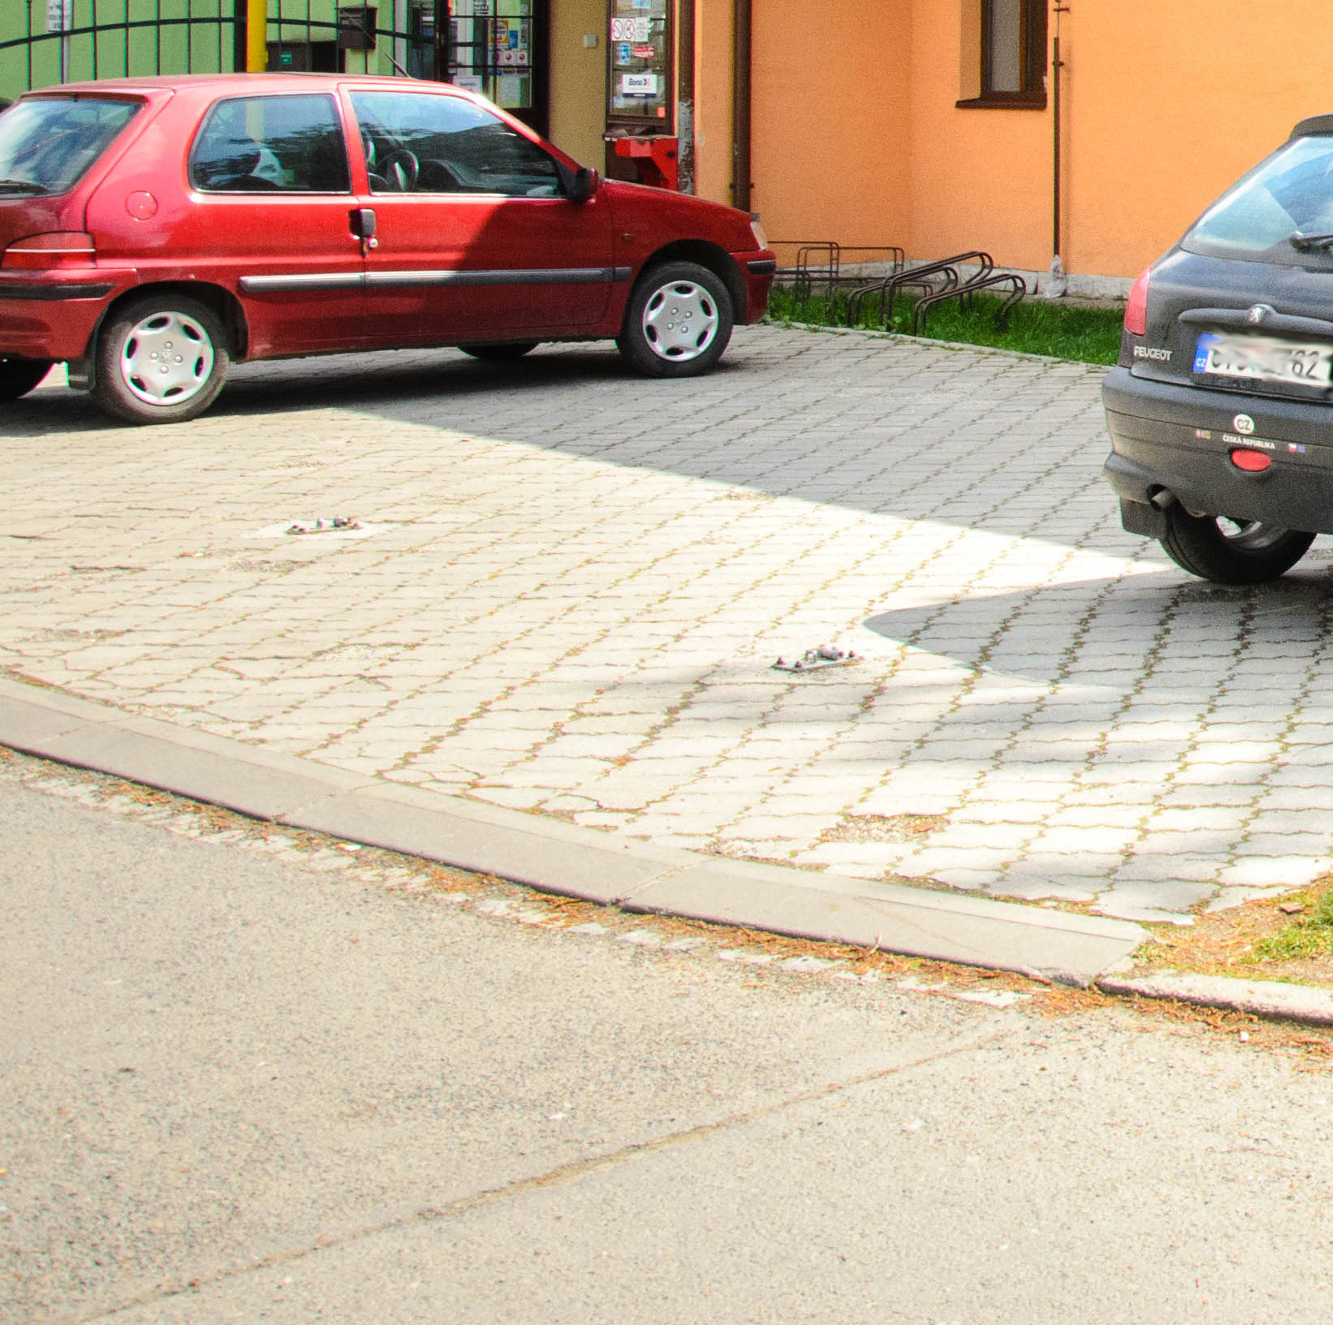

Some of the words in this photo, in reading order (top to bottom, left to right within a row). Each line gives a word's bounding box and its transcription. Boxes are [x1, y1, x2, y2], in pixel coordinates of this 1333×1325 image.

[1133, 346, 1172, 361] PEUGEOT
[1195, 358, 1206, 368] CZ
[1237, 418, 1251, 430] CZ
[1223, 434, 1242, 444] ČESKÁ
[1243, 437, 1276, 449] REPUBLIKA
